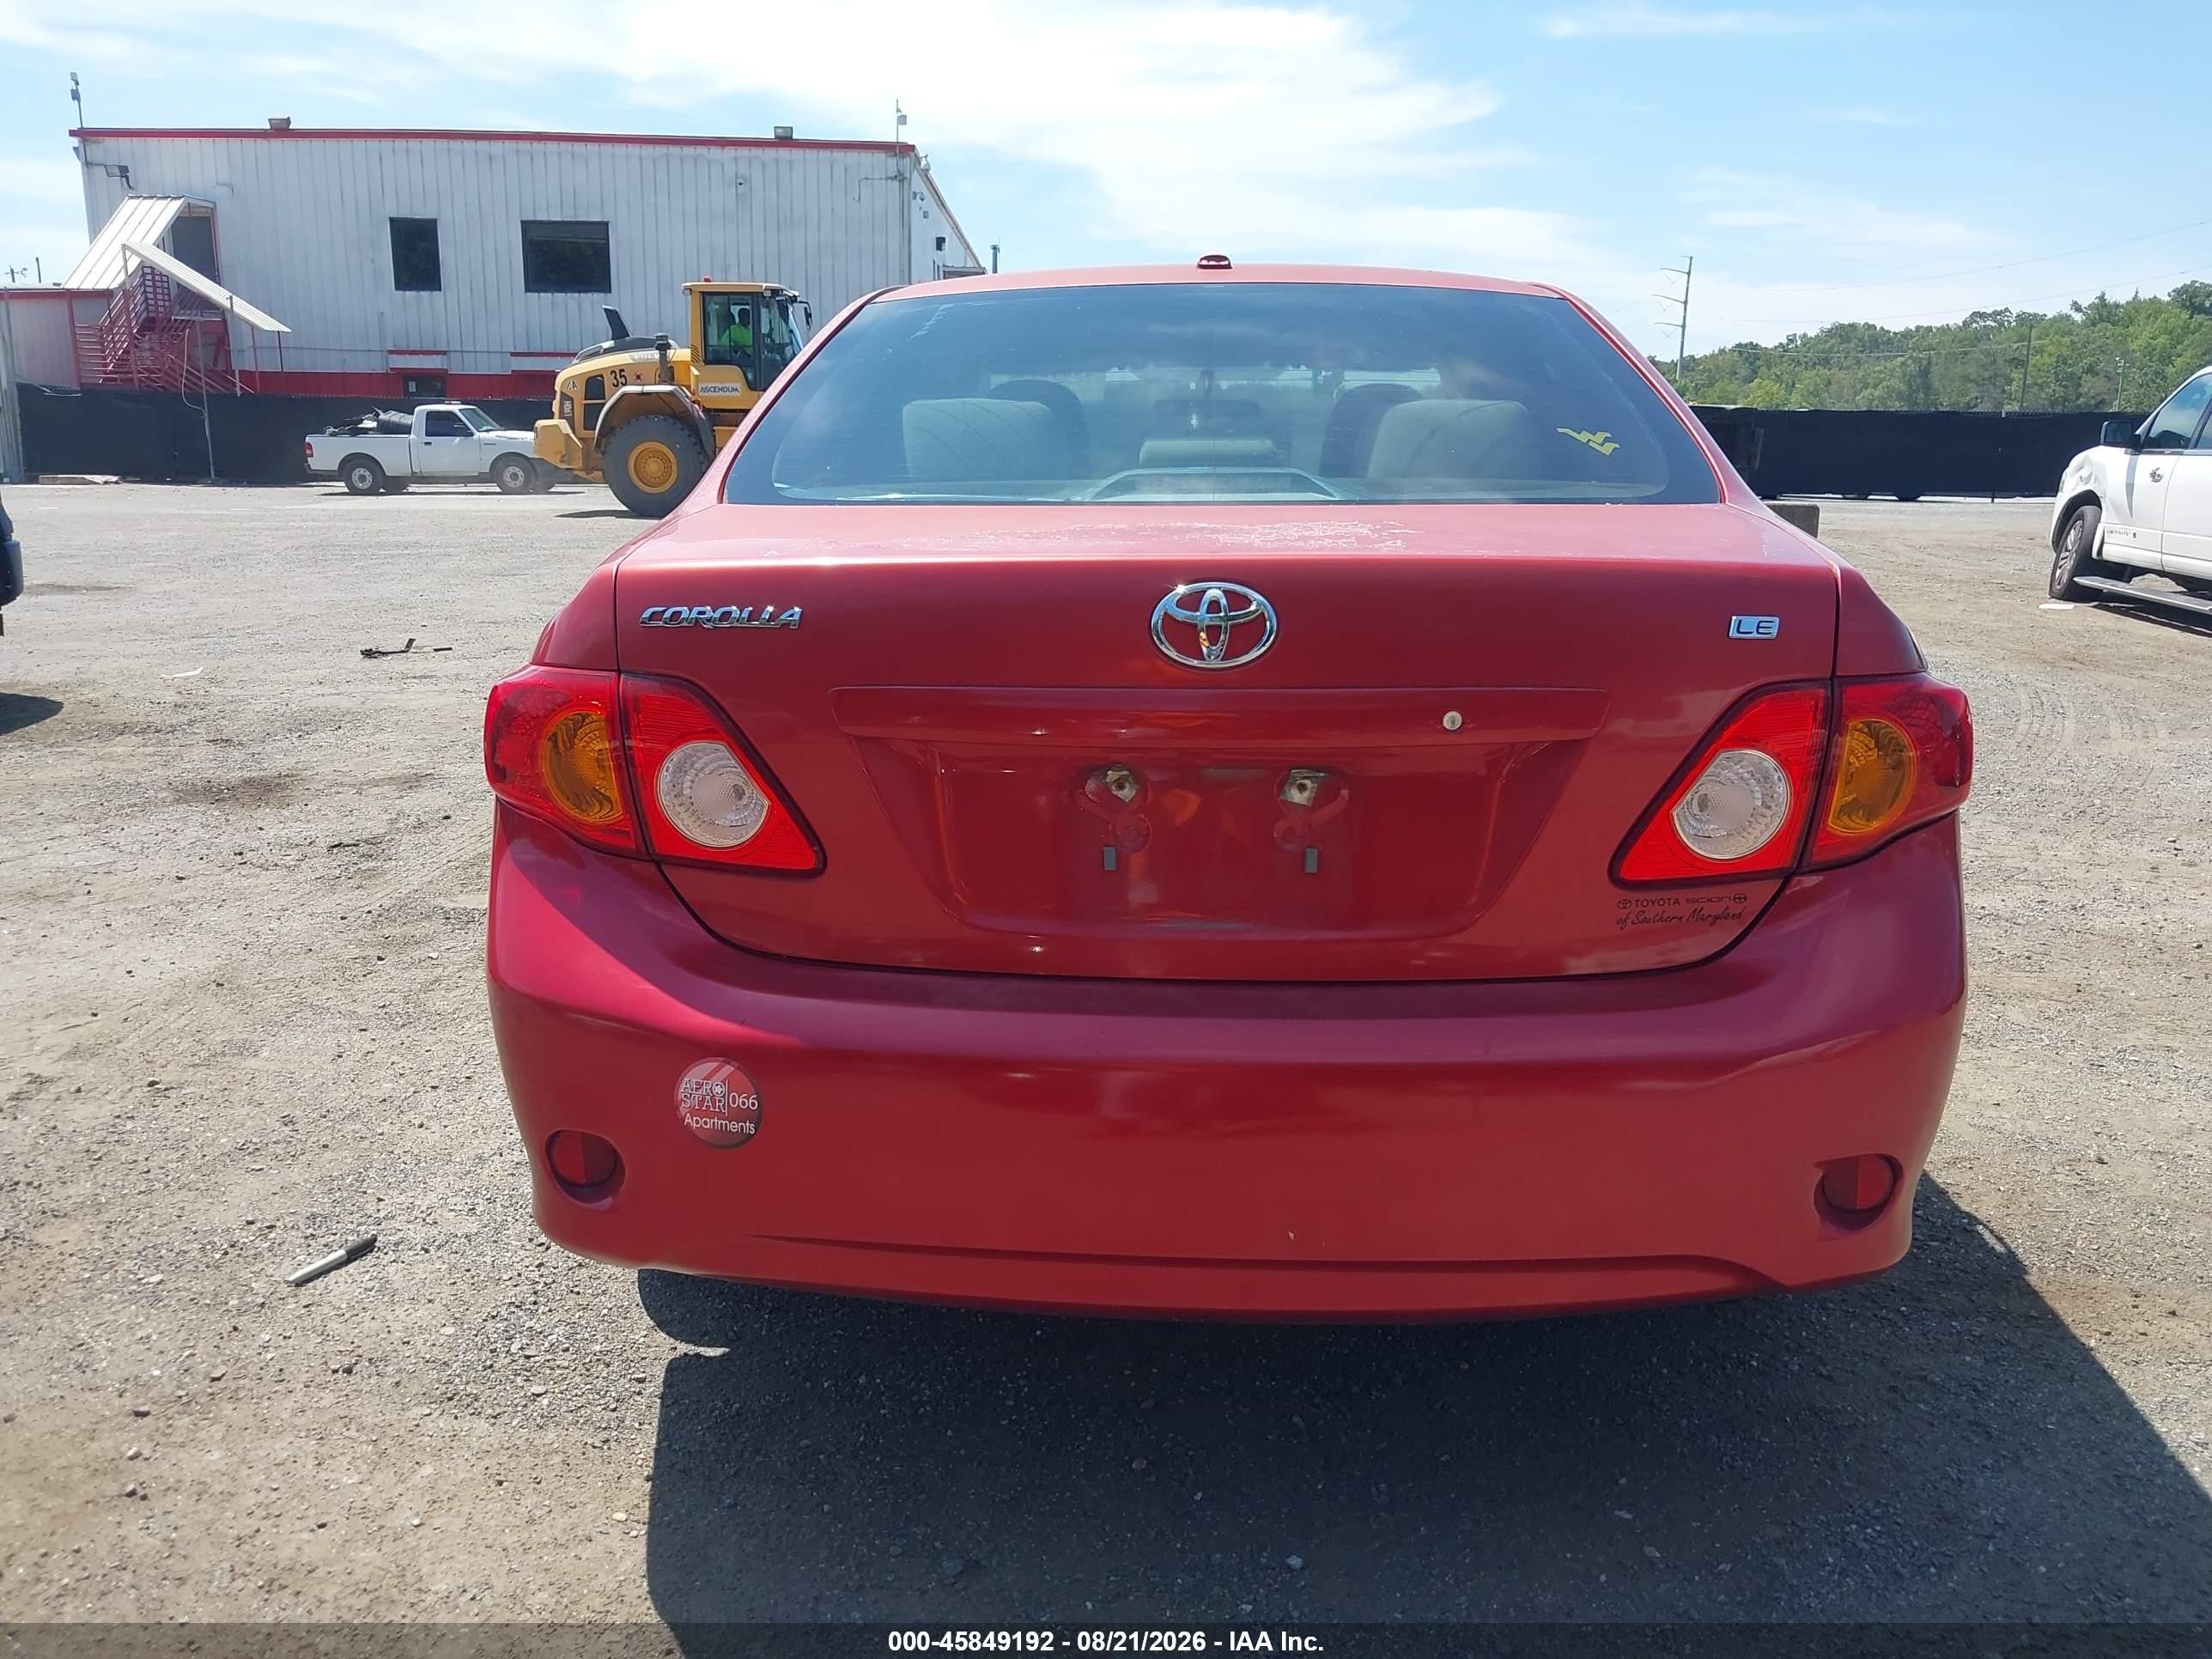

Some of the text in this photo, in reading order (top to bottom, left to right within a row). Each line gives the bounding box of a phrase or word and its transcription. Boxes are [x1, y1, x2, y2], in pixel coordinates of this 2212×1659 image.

[610, 368, 629, 389] 35
[700, 386, 740, 394] ASCENDUM
[639, 605, 804, 629] COROLLA
[1736, 619, 1776, 635] LE
[1634, 897, 1681, 908] TOYOTA
[1616, 906, 1746, 930] of Southern Maryland
[680, 1078, 726, 1097] AERO
[681, 1092, 727, 1114] STAR
[729, 1091, 759, 1111] 066
[684, 1113, 756, 1134] Apartments
